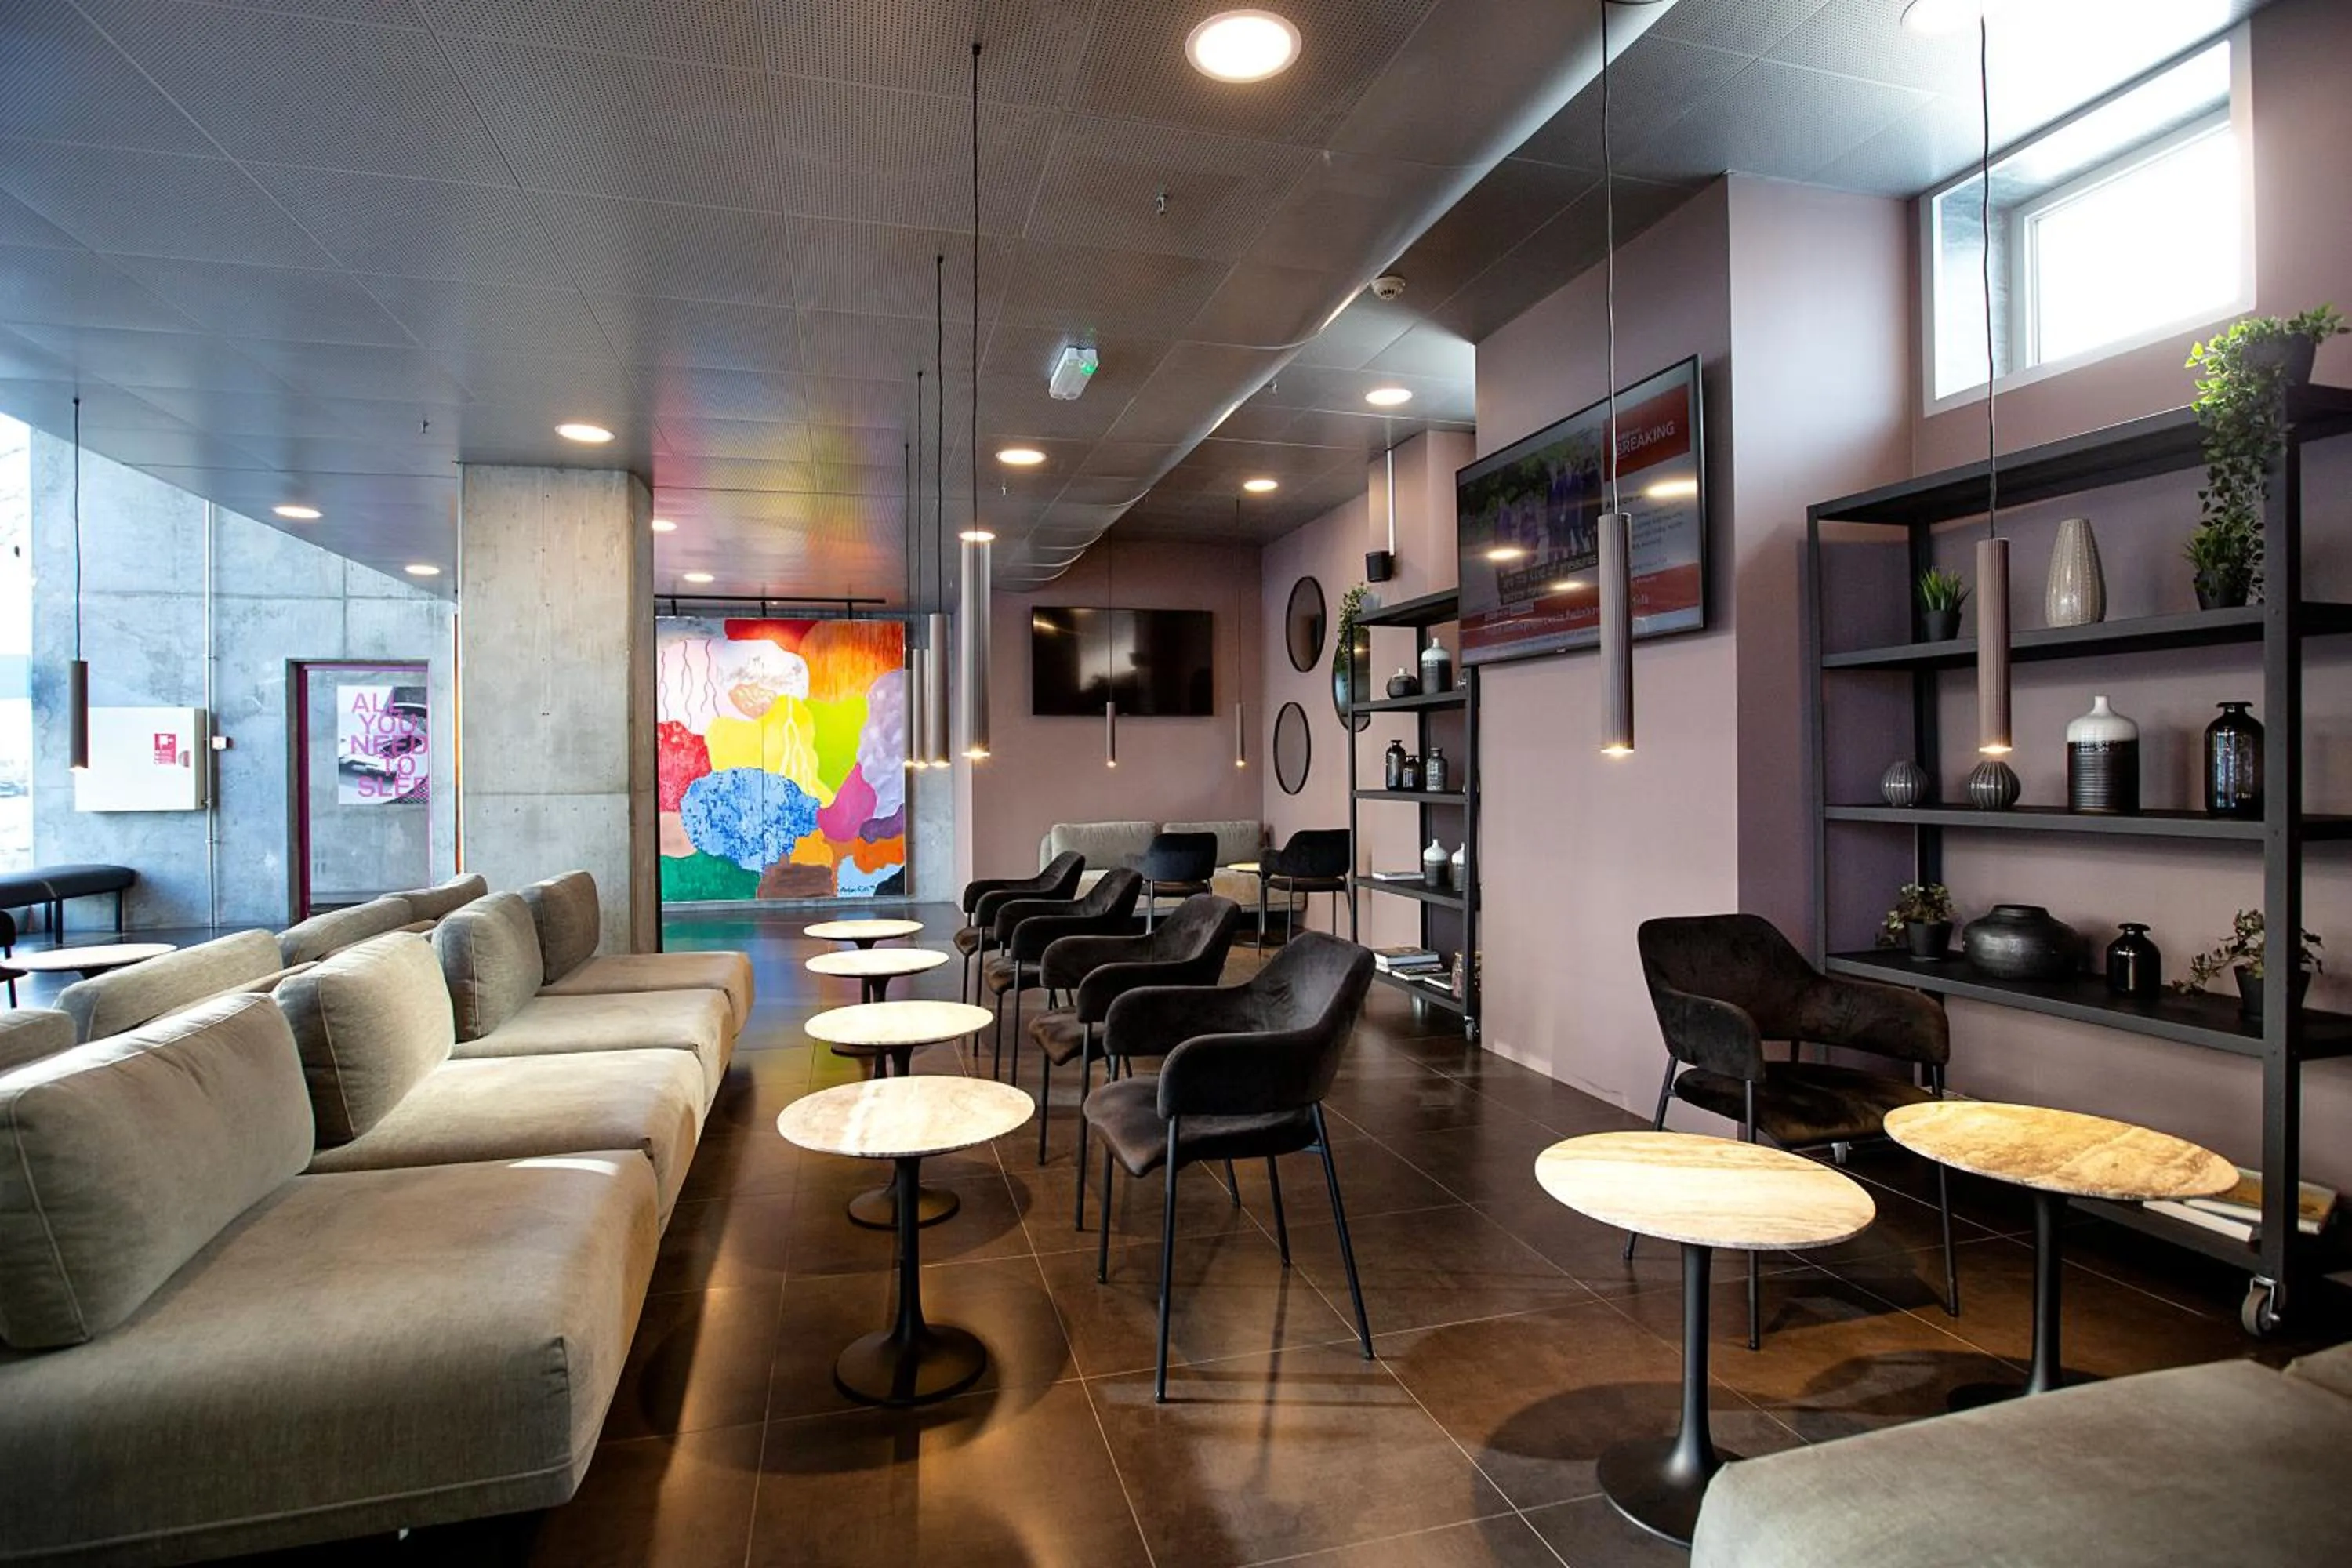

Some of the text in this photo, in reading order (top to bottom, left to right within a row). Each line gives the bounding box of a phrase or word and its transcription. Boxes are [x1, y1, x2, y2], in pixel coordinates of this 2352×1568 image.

[1617, 419, 1675, 455] BREAKING
[352, 692, 404, 713] ALL
[359, 713, 418, 734] YOU
[350, 735, 428, 757] NEED
[379, 755, 416, 776] TO
[358, 775, 429, 797] SLEE
